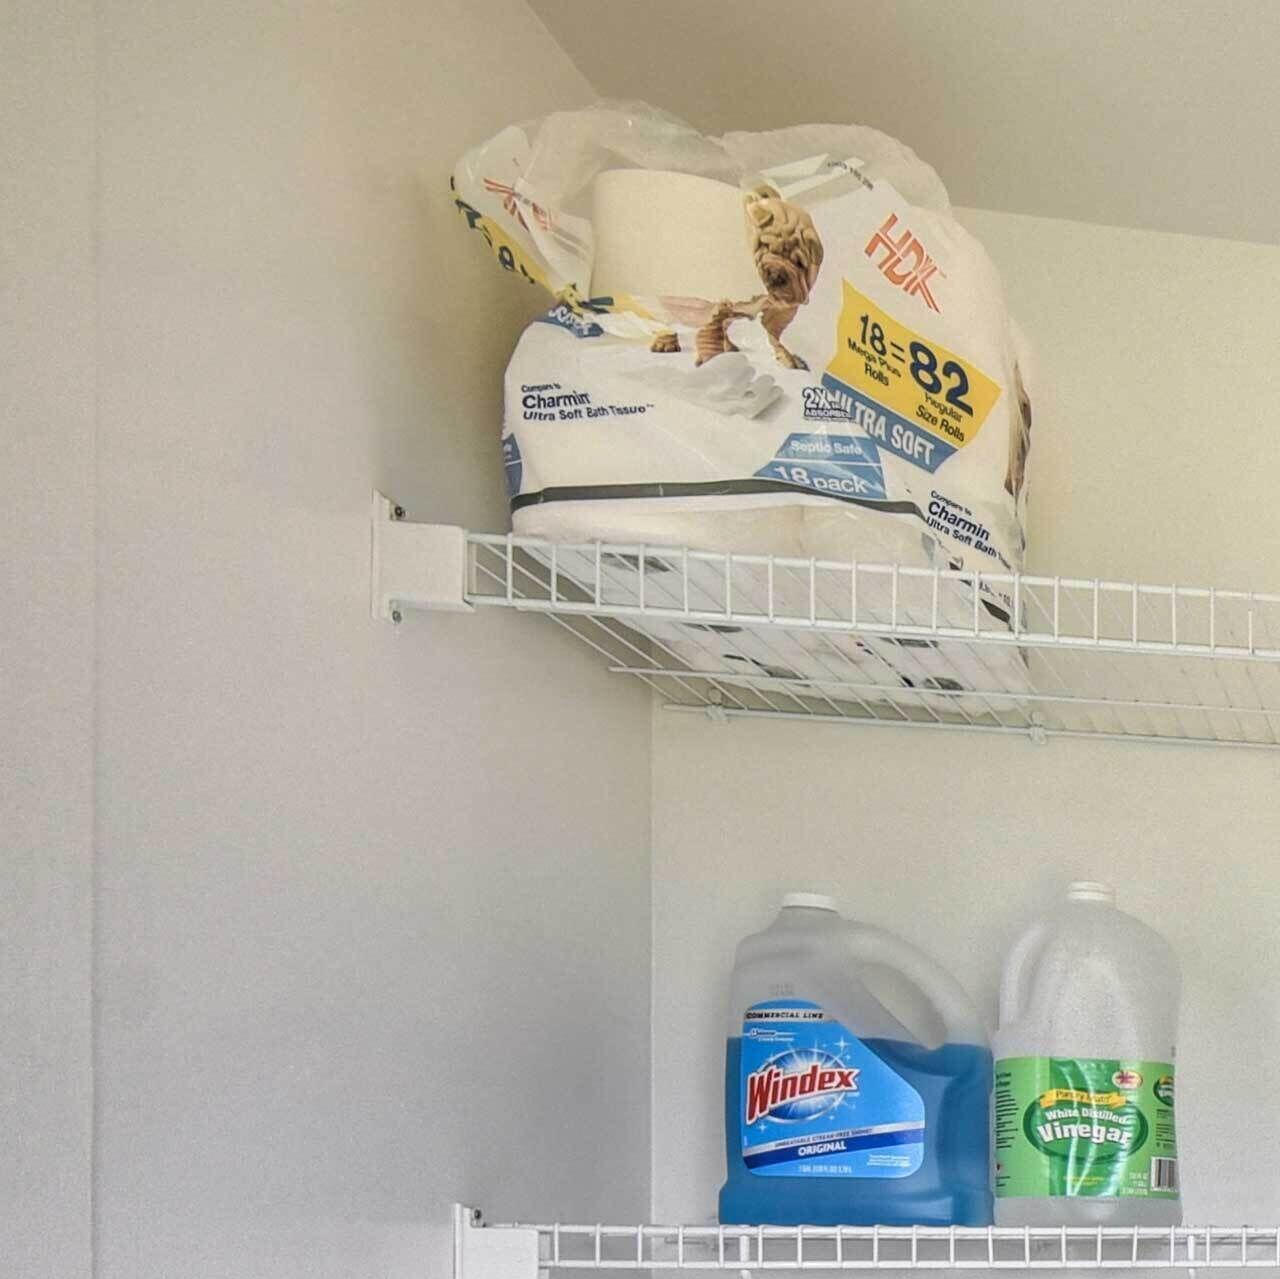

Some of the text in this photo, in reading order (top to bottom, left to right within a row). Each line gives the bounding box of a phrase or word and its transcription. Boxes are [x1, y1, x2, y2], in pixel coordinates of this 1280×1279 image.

[865, 363, 889, 387] Rolls
[522, 390, 591, 409] Charmin
[523, 407, 609, 421] Ultra Soft Bath
[916, 404, 965, 442] Size Rolls
[891, 422, 936, 464] SOFT
[775, 466, 869, 494] 18 pack
[928, 500, 990, 541] Charmin
[926, 517, 998, 558] Ultra Soft Bath
[746, 1012, 800, 1020] COMMERCIAL
[746, 1064, 861, 1126] Windex
[1045, 1108, 1080, 1121] White
[1037, 1122, 1133, 1147] Vinegar
[798, 1141, 847, 1156] ORIGINAL
